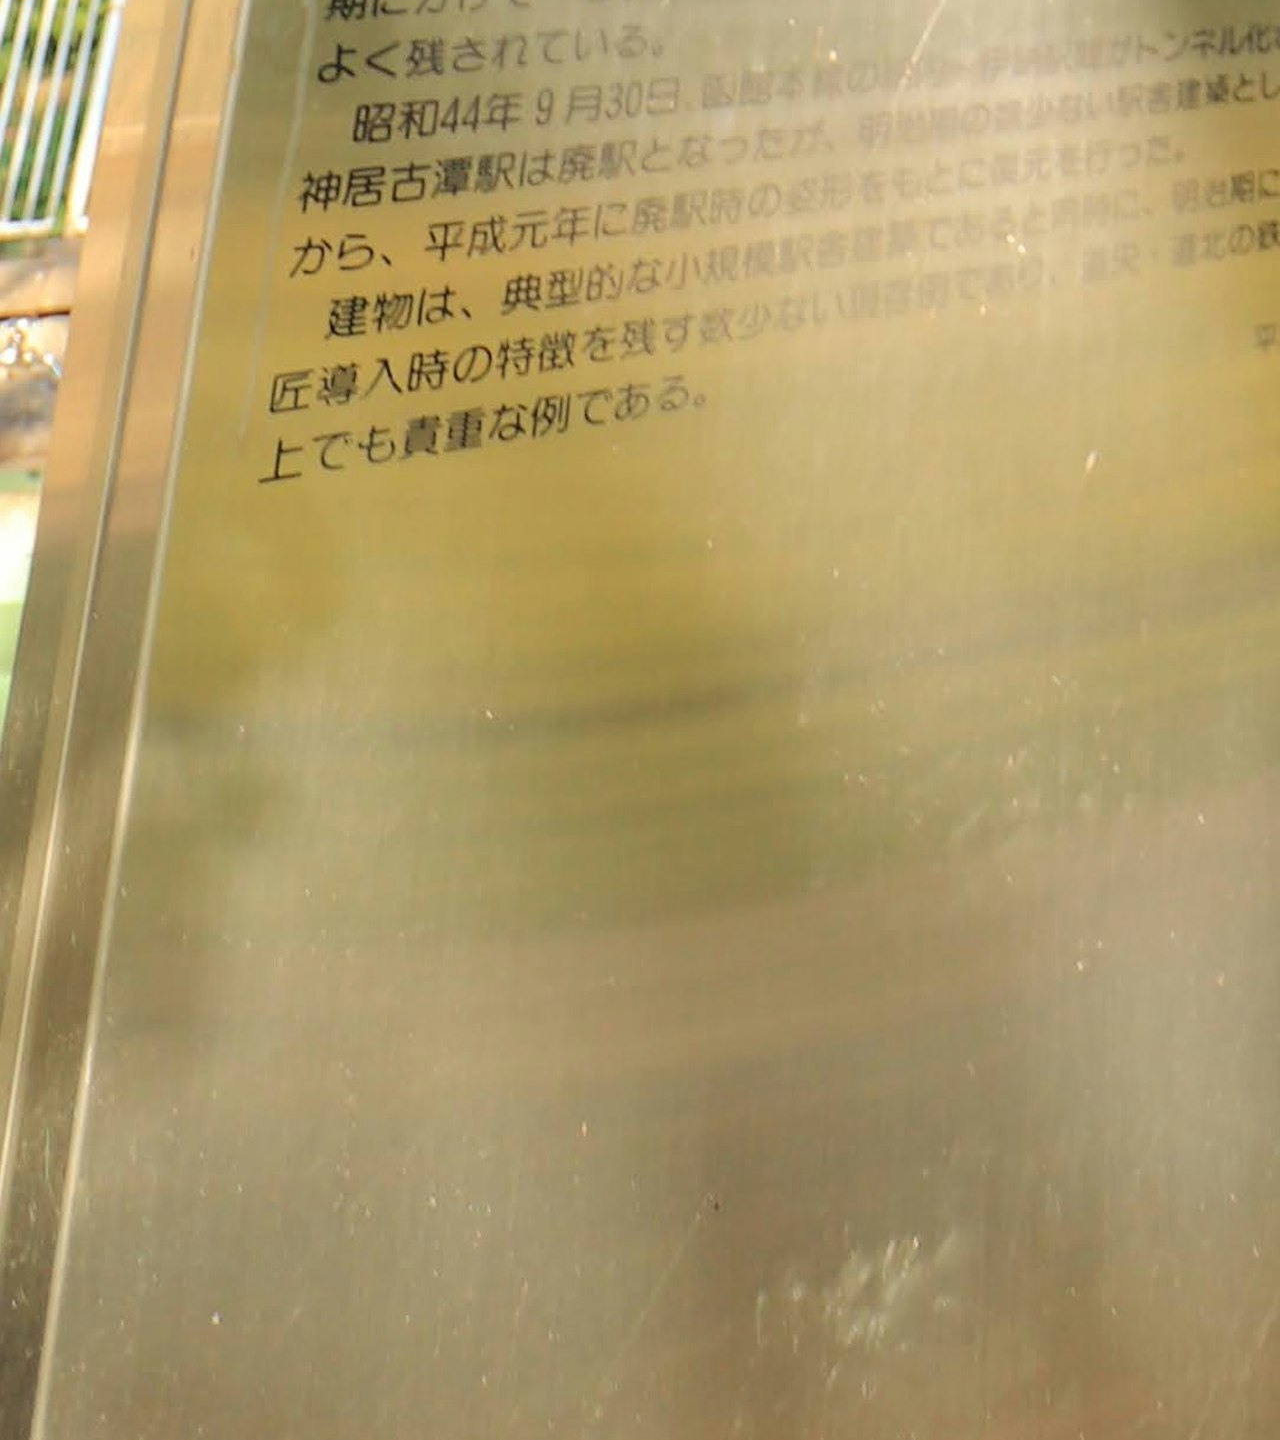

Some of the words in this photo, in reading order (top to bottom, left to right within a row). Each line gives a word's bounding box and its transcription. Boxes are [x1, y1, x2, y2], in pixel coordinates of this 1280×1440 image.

[315, 23, 667, 86] よく残されている。
[257, 375, 710, 485] 上でも貴重な例である。
